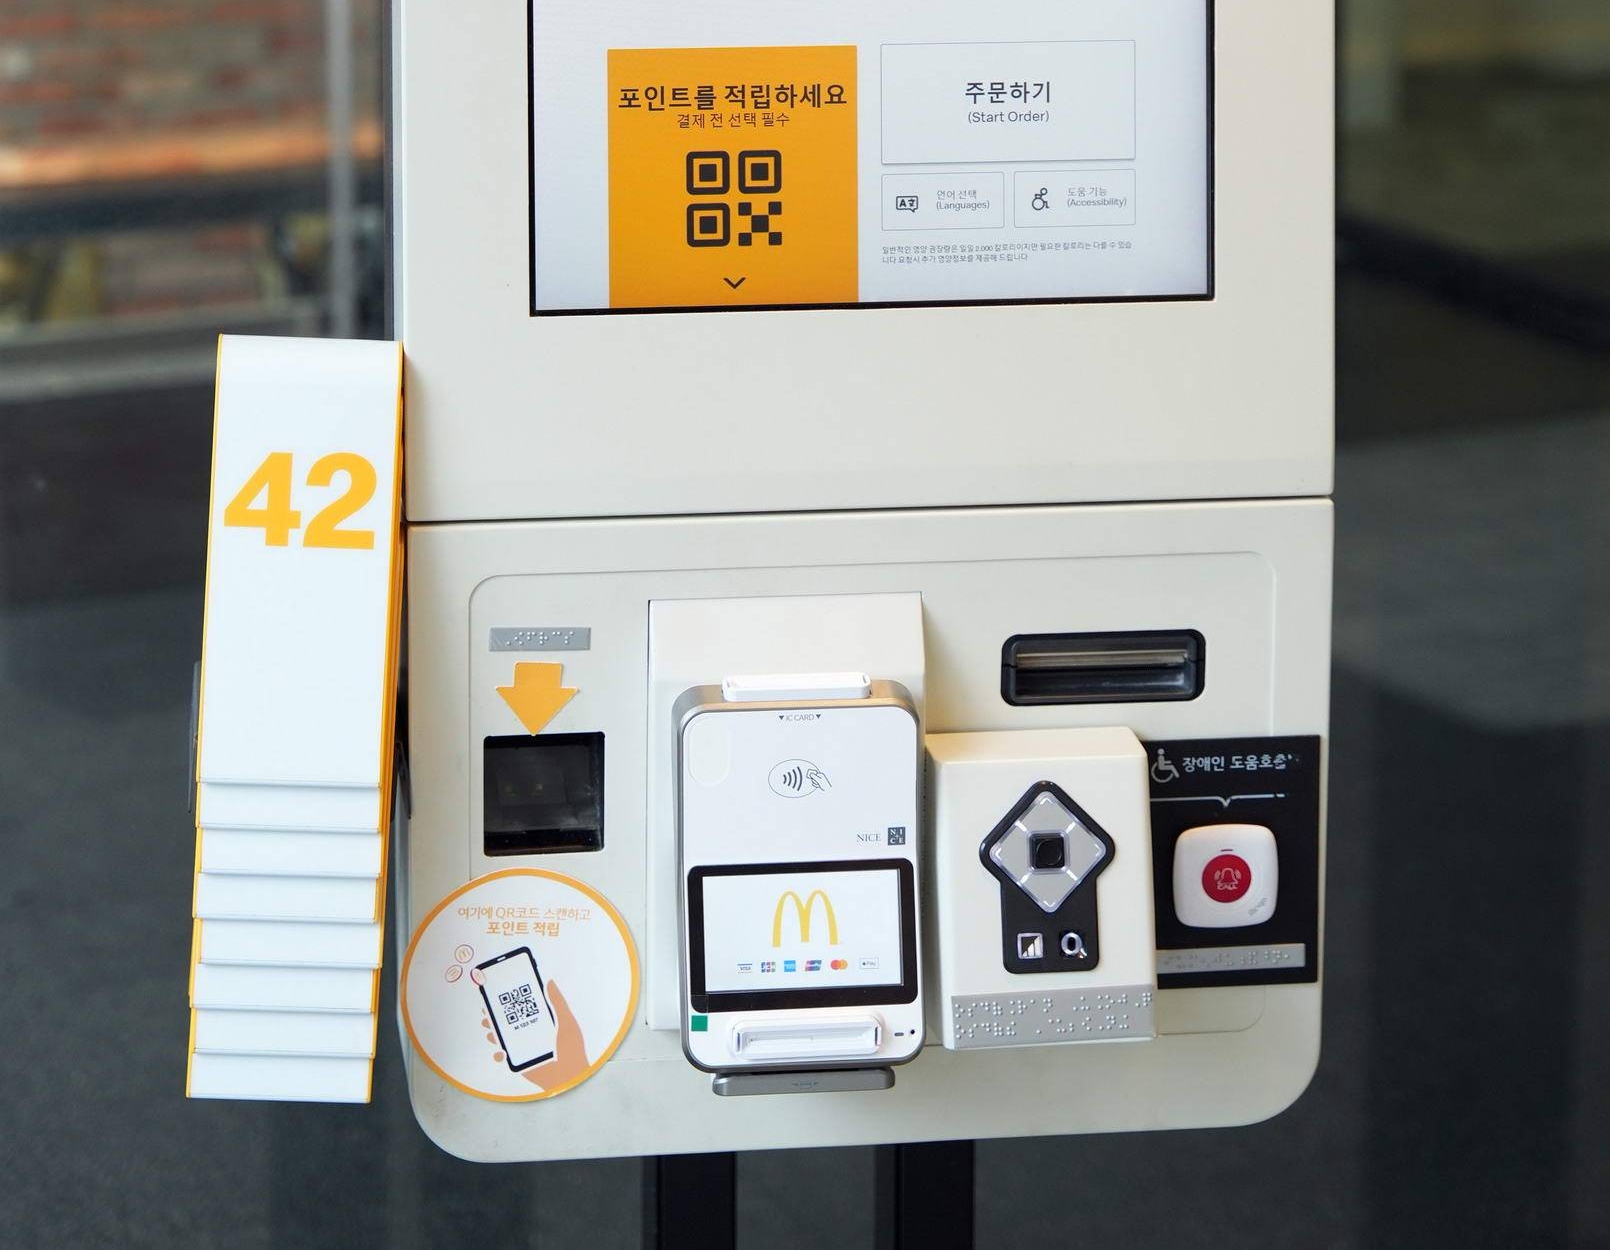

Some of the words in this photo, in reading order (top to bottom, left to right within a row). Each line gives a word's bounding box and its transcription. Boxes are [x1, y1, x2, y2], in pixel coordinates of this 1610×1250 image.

[619, 86, 718, 110] 포인트를
[725, 84, 847, 110] 적립하세요
[965, 82, 1049, 104] 주문하기
[678, 111, 707, 129] 결제
[710, 111, 723, 129] 전
[729, 111, 757, 128] 선택
[761, 110, 791, 127] 필수
[968, 112, 1004, 123] (Start
[1008, 110, 1049, 123] Order)
[937, 190, 955, 200] 언어
[959, 190, 976, 199] 선택
[1068, 187, 1087, 197] 도움
[1088, 187, 1106, 197] 기능
[936, 200, 989, 211] (Languages)
[1067, 198, 1127, 208] (Accessibility)
[224, 452, 377, 550] 42
[1183, 756, 1224, 772] 장애인
[857, 834, 880, 842] NICE
[457, 907, 493, 920] 여기에
[496, 907, 540, 920] QR코드
[543, 908, 590, 920] 스캔하고
[486, 922, 528, 935] 포인트
[533, 922, 559, 936] 적립
